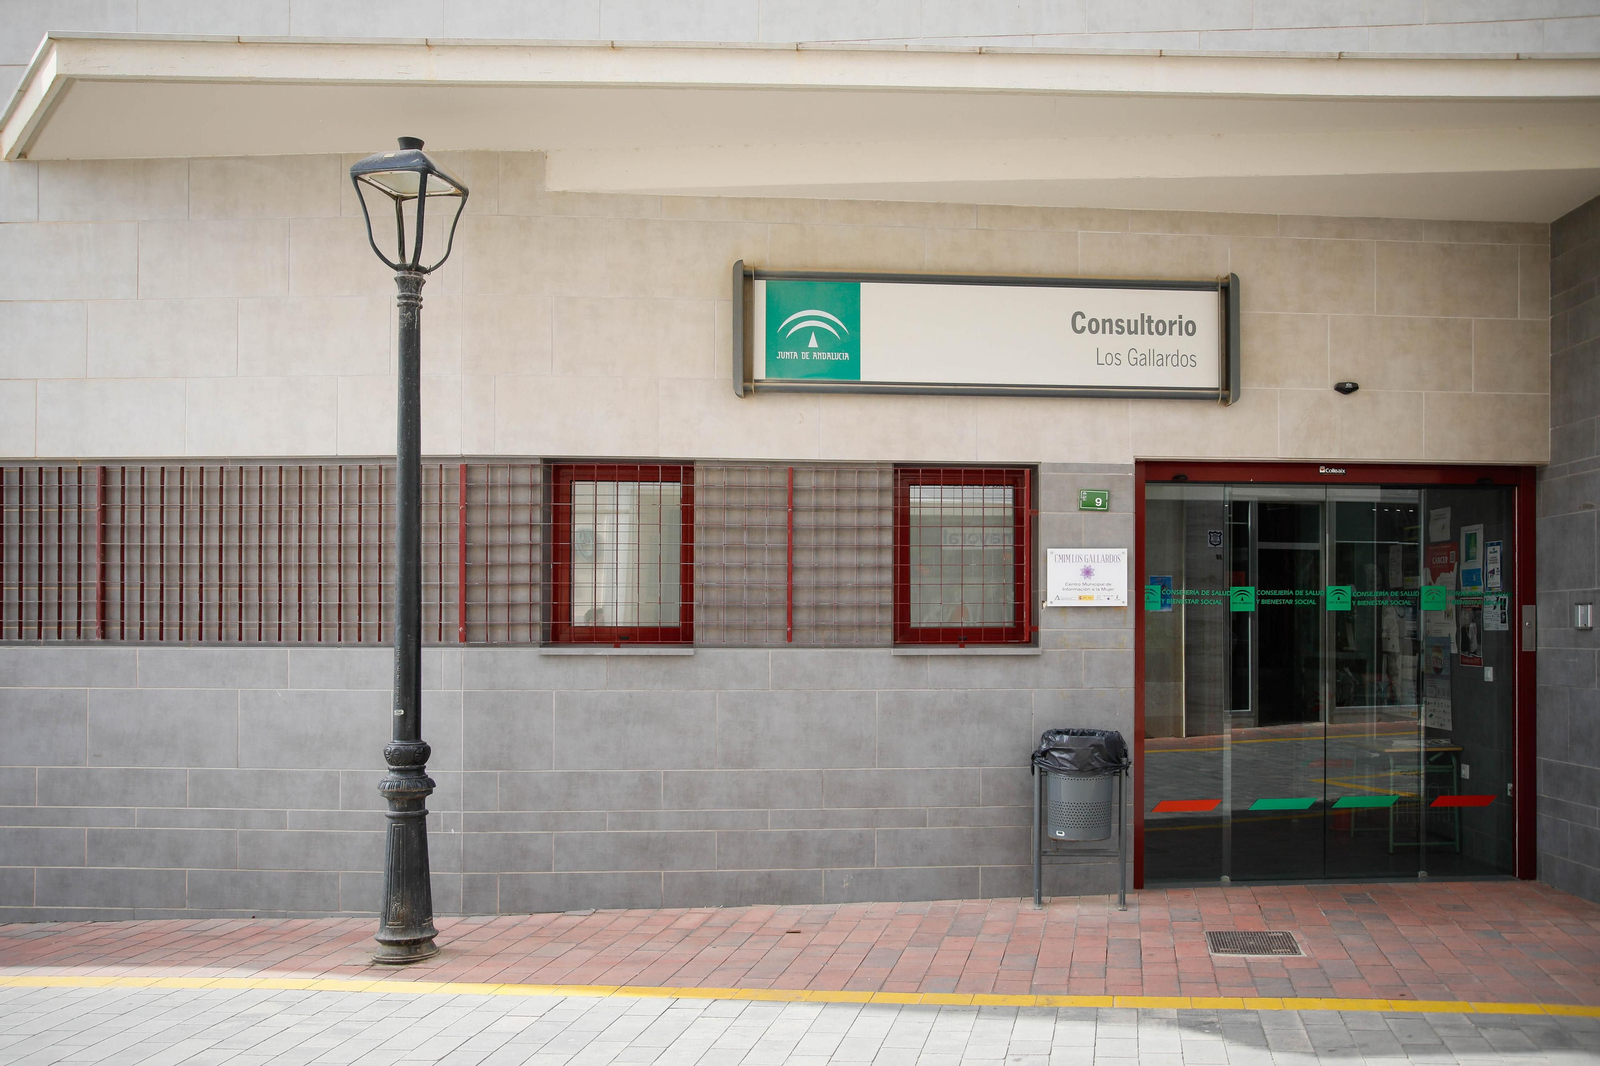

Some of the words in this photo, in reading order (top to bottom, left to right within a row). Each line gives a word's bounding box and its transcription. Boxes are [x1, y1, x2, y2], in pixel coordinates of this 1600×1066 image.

[1071, 310, 1197, 337] Consultorio
[776, 351, 798, 360] JUNTA
[801, 352, 810, 360] DE
[1096, 347, 1122, 366] Los
[1128, 348, 1197, 368] Gallardos
[1095, 498, 1102, 506] 9
[1054, 554, 1070, 563] CMIM
[1072, 554, 1083, 563] LOS
[1084, 554, 1121, 563] GALLARDOS
